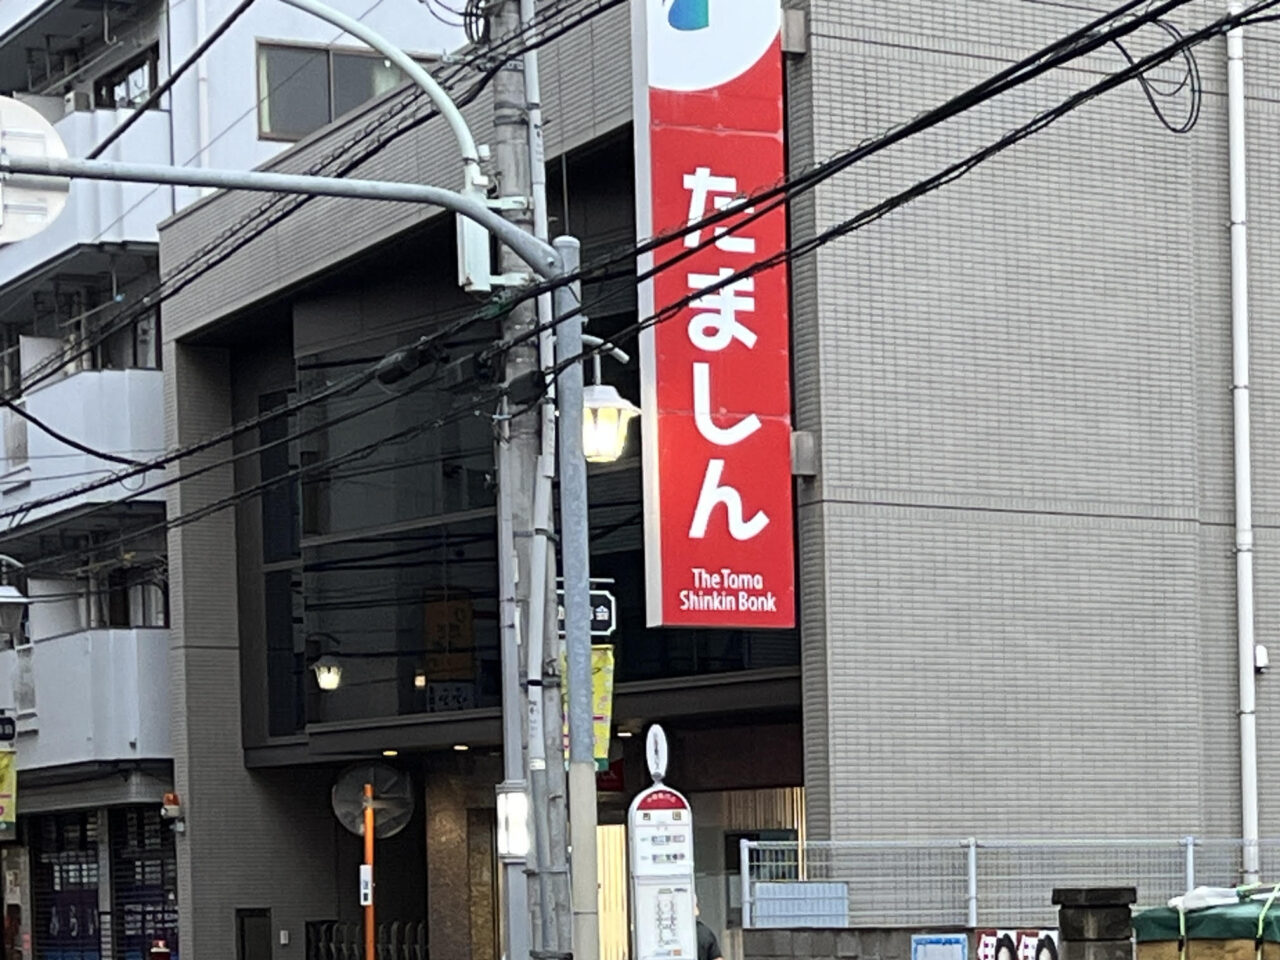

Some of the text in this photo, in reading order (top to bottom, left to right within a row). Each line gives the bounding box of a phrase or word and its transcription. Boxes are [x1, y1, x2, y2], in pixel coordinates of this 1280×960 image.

[683, 167, 770, 541] たましん
[691, 568, 763, 589] The Tama
[679, 590, 777, 612] Shinkin Bank
